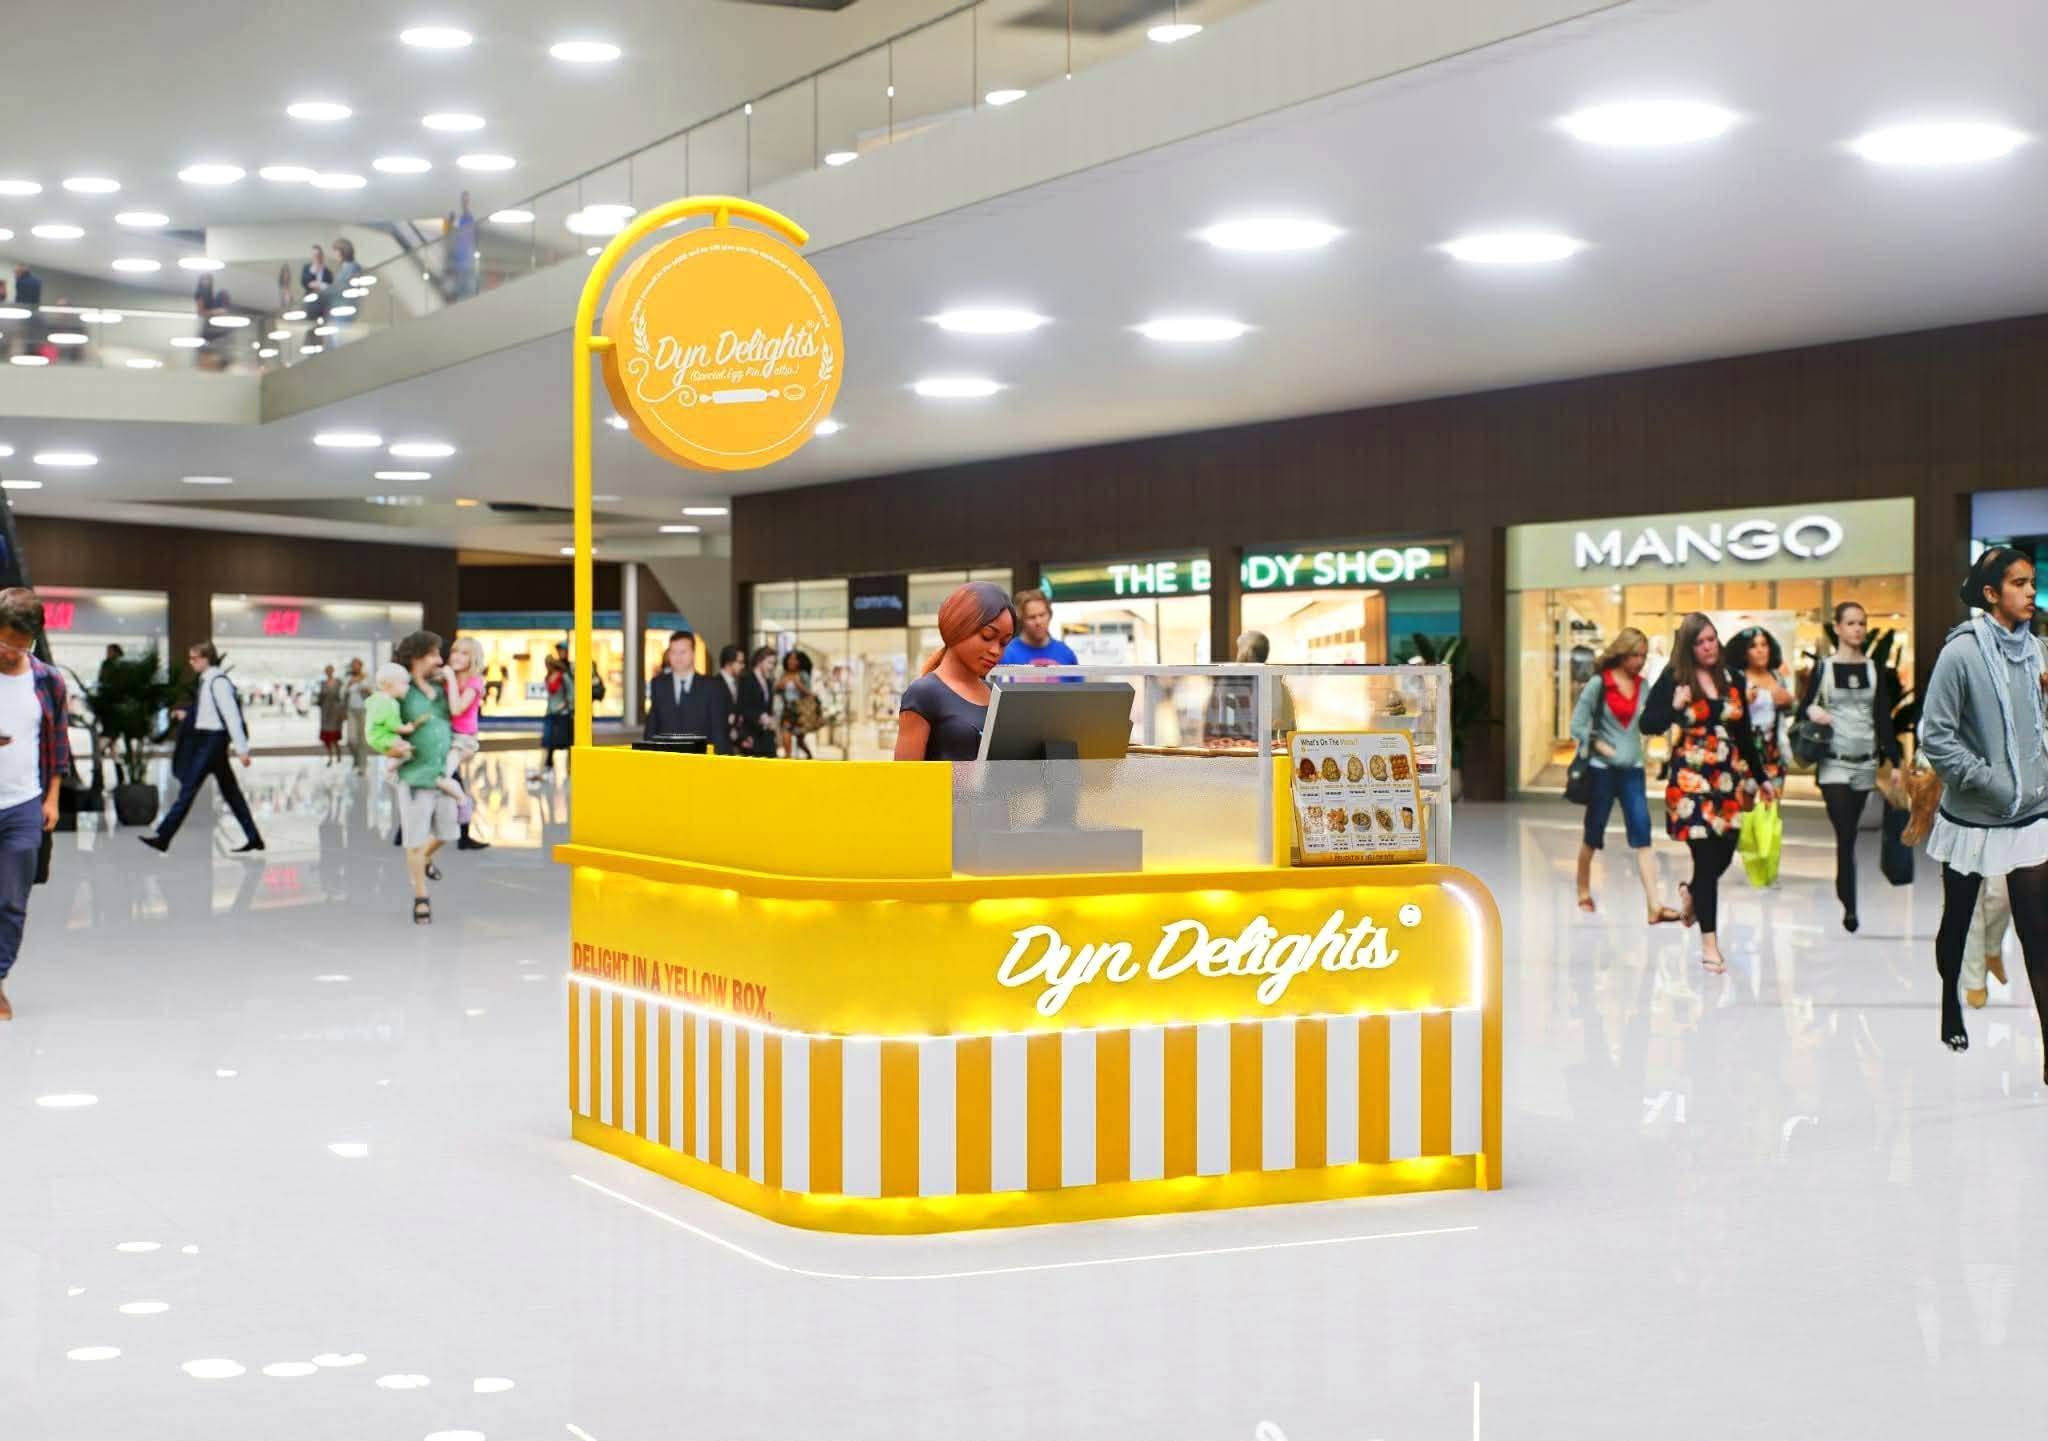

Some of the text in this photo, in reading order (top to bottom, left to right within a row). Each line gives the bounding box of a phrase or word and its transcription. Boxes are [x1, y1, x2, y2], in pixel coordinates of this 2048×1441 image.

[655, 335, 711, 387] Dyn
[1575, 515, 1844, 569] MANGO
[1107, 561, 1178, 595] THE
[1190, 553, 1303, 592] BDY
[573, 941, 629, 984] DELIGHT
[632, 954, 647, 988] IN
[651, 959, 662, 993] A
[664, 962, 728, 1005] YELLOW
[997, 909, 1399, 1016] Dyn Delights
